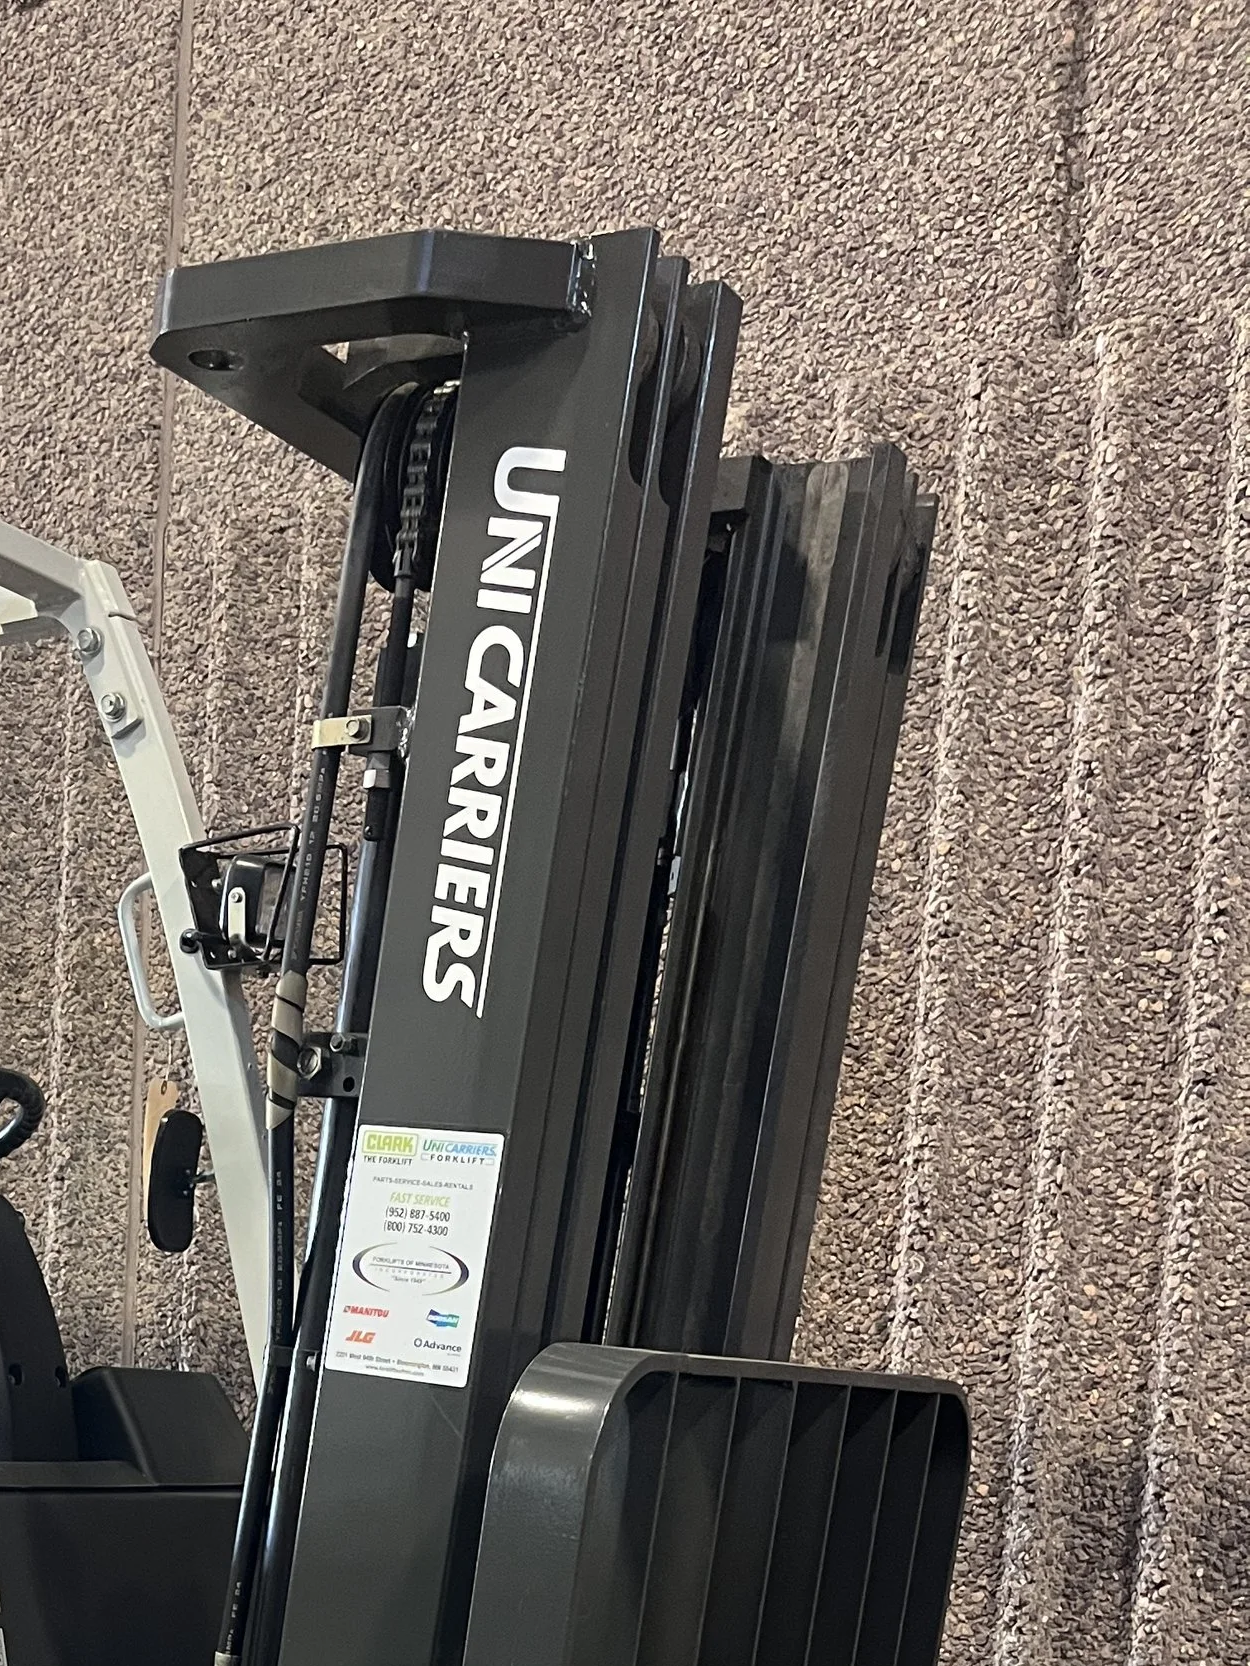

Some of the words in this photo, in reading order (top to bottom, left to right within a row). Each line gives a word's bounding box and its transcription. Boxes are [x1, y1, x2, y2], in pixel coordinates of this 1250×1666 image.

[366, 1133, 414, 1153] CLARK
[363, 1155, 376, 1164] THE
[378, 1156, 413, 1166] FORKLIFT
[429, 1153, 486, 1166] FORKLIFT
[390, 1192, 412, 1203] FAST
[415, 1194, 451, 1208] SERVICE
[385, 1206, 408, 1219] (952)
[410, 1208, 450, 1222] 887-5400
[383, 1219, 406, 1233] (800)
[408, 1222, 448, 1236] 752-4300
[350, 1305, 390, 1319] MANITOU
[345, 1330, 376, 1344] JLG
[422, 1340, 462, 1353] Advance
